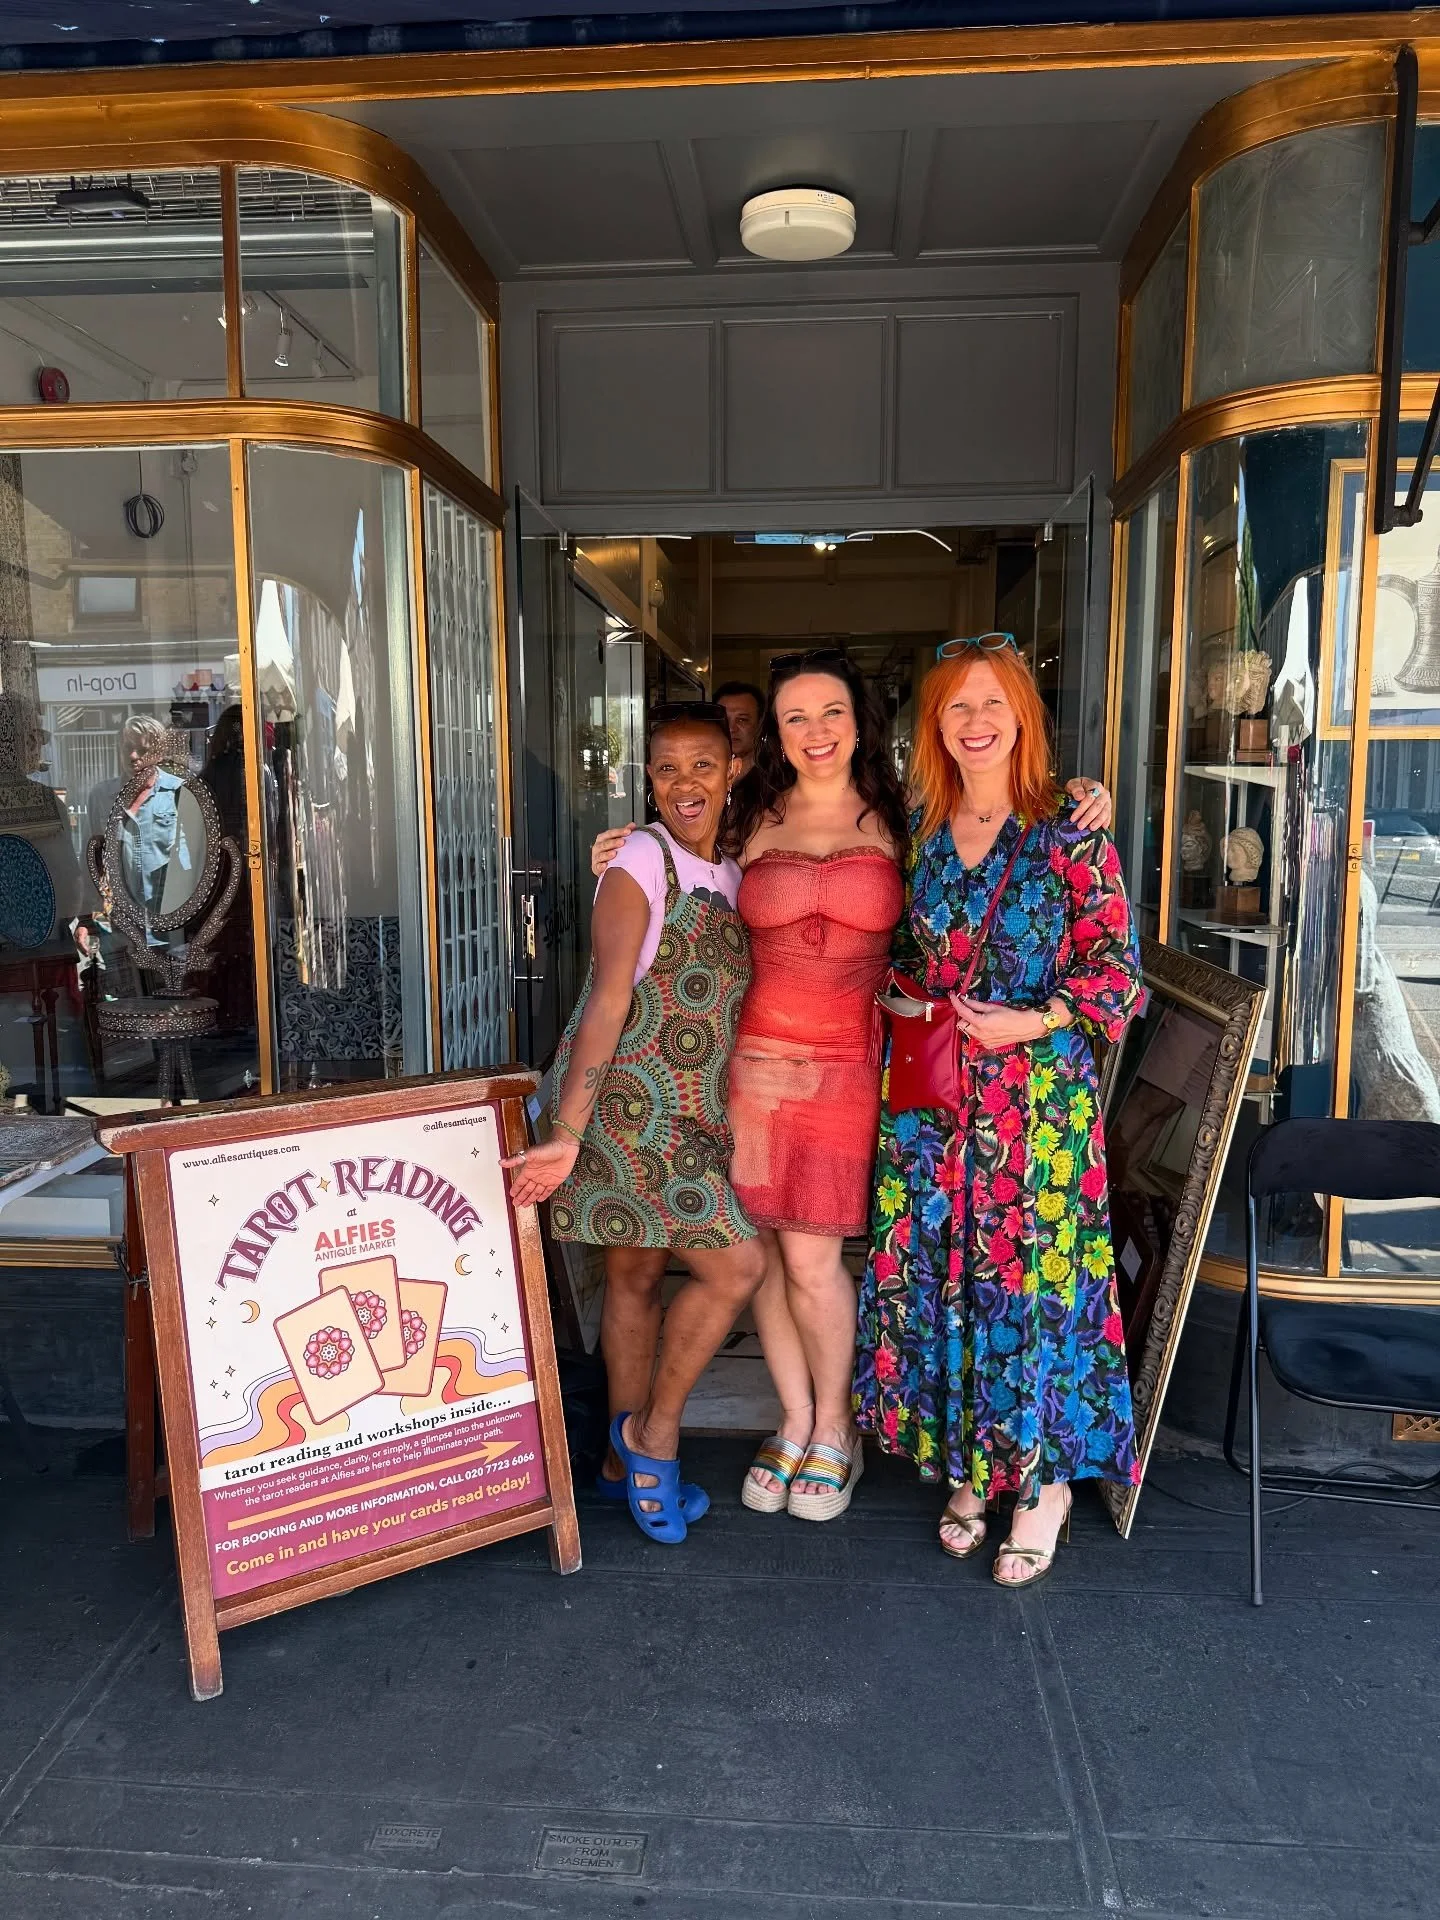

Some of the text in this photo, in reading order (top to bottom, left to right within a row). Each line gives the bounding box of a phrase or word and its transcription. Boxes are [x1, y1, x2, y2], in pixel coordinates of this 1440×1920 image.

[422, 1115, 487, 1133] @alfiesantiques
[182, 1144, 300, 1169] www.alfiesantiques.com
[214, 1155, 484, 1291] TAROT READING
[346, 1208, 357, 1217] at
[314, 1218, 396, 1252] ALFIES
[315, 1238, 396, 1262] ANTIQUE MARKET
[214, 1411, 523, 1501] Whether you seek guidance, clarity, or simply, a glimpse into the unknown,
[224, 1461, 266, 1481] tarot
[270, 1444, 332, 1469] reading
[335, 1432, 364, 1451] and
[367, 1413, 448, 1443] workshops
[244, 1427, 504, 1507] the tarot readers at Alfies are here to help illuminate your path.
[214, 1451, 535, 1554] FOR BOOKING AND MORE INFORMATION, CALL 020 7723 6066
[226, 1471, 532, 1576] Come in and have your cards read today!
[549, 1834, 641, 1848] SMOKE OUTLET
[574, 1847, 610, 1857] FROM
